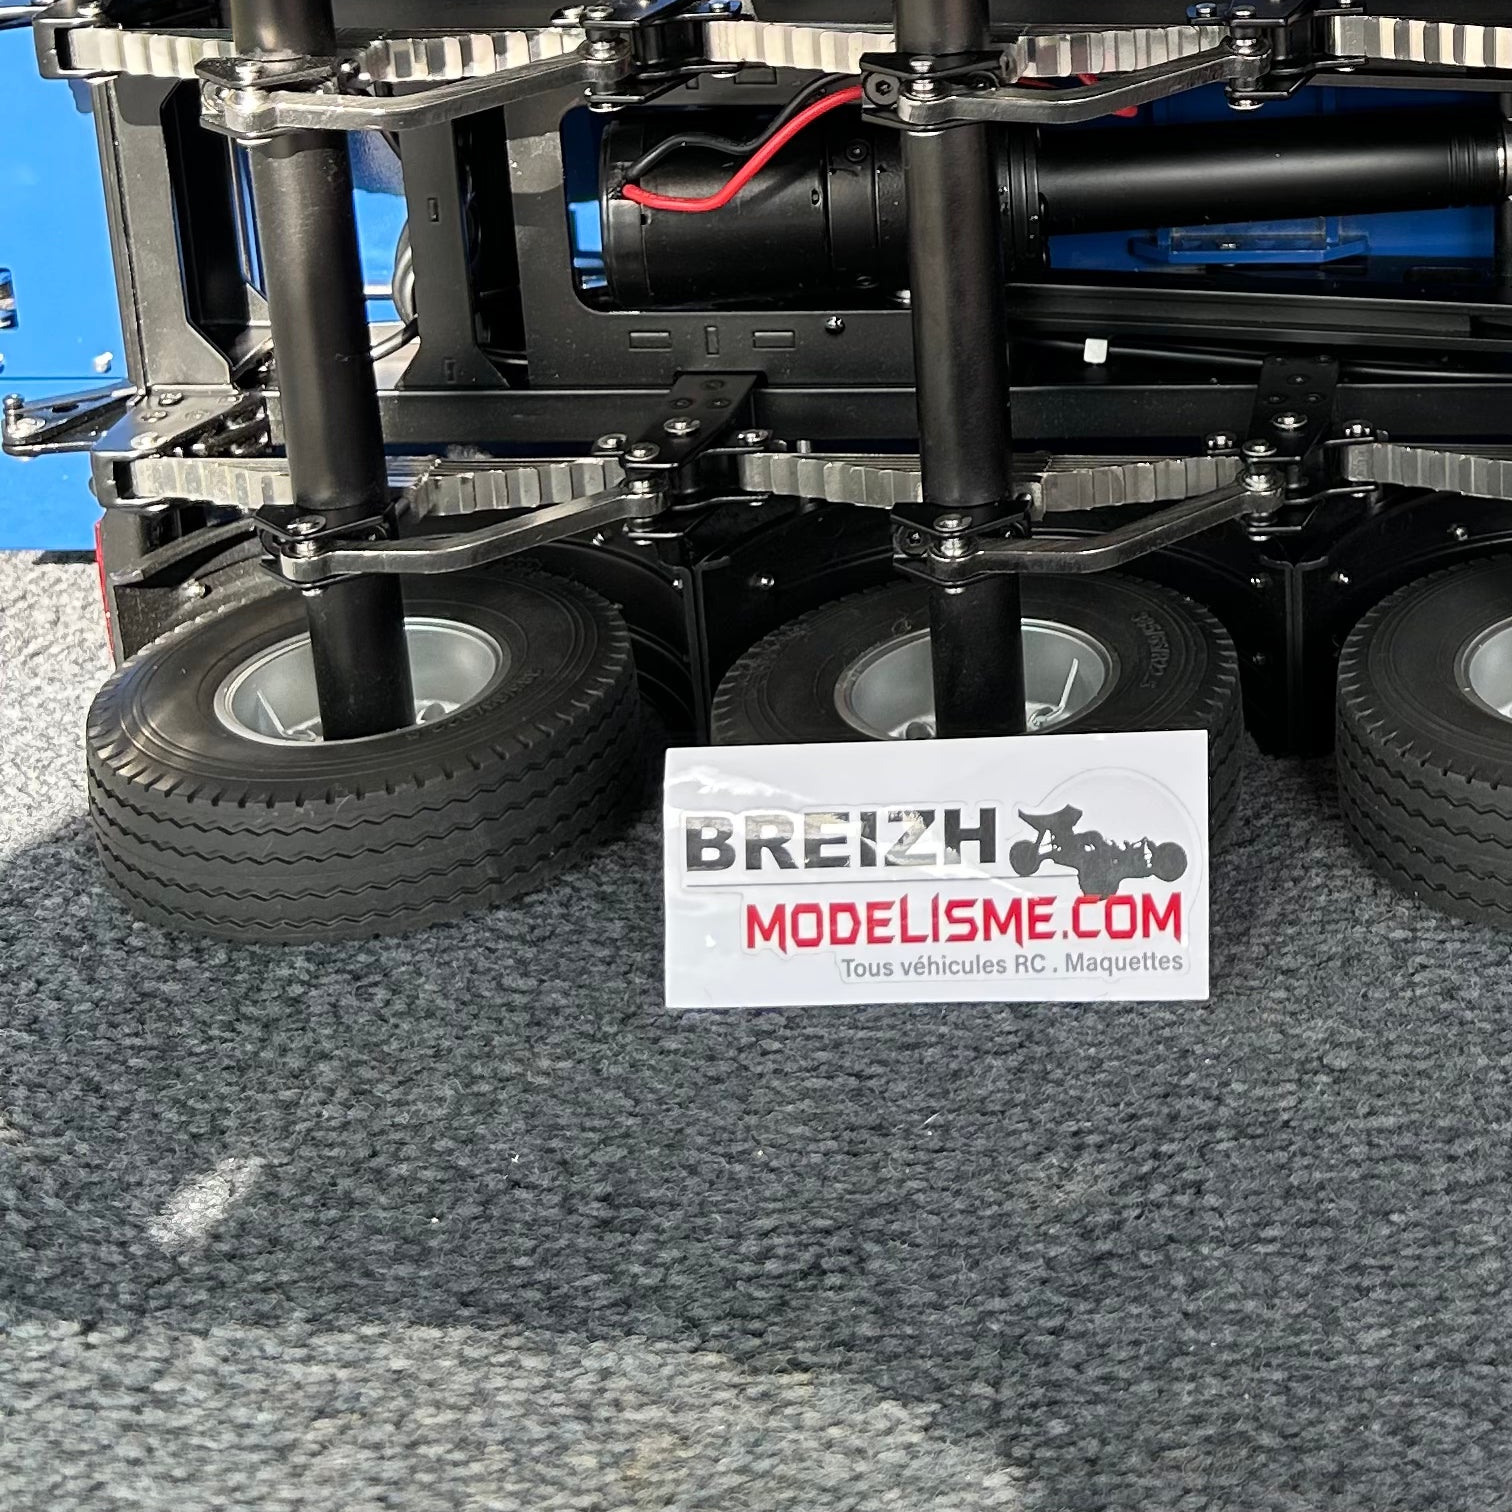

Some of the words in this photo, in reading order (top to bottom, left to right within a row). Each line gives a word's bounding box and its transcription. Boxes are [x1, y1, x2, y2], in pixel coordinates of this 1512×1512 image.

[685, 807, 996, 872] BREIZH
[746, 891, 1183, 955] MODELISME.COM
[841, 957, 896, 979] Tous
[899, 954, 1007, 978] véhicules
[1014, 953, 1047, 974] RC
[1065, 951, 1184, 980] Maquettes
